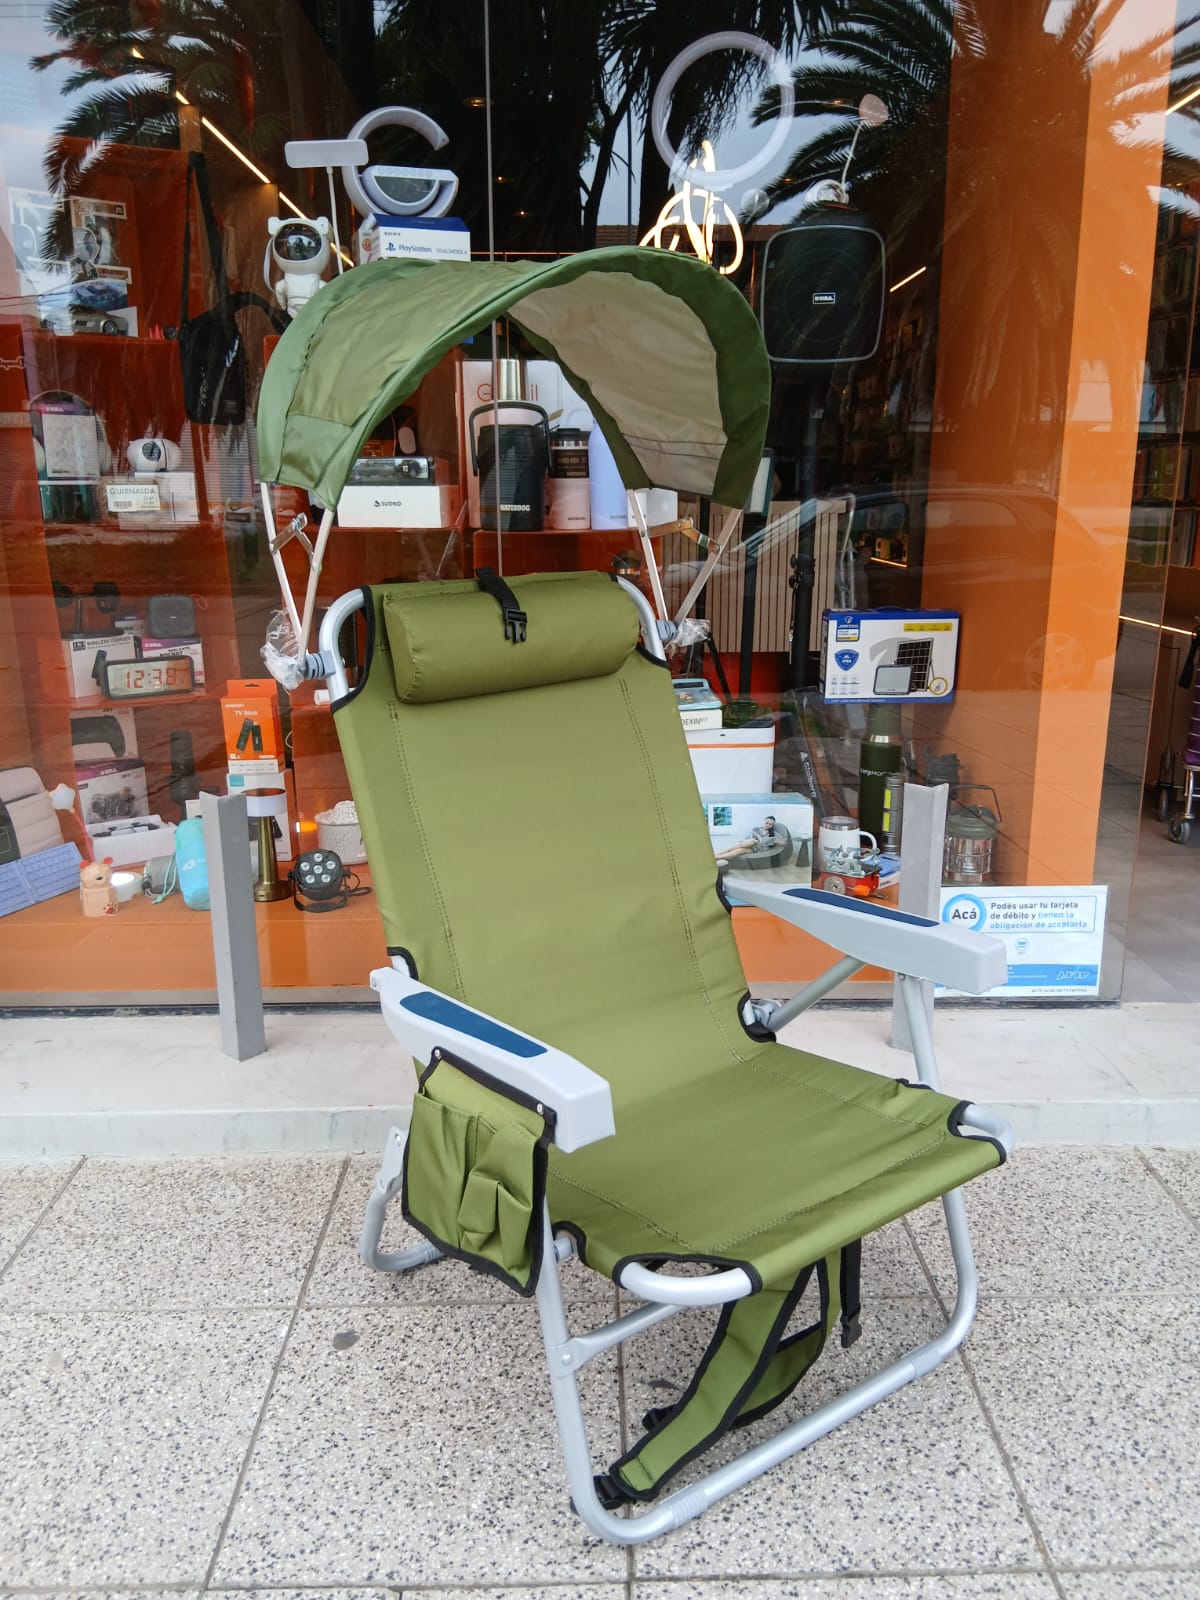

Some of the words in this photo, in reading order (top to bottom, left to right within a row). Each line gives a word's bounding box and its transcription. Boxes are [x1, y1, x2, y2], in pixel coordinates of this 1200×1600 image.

[399, 244, 432, 252] PlayStation
[990, 901, 1016, 910] Podés
[1050, 901, 1078, 910] tarjeta
[951, 907, 977, 920] Acá
[990, 911, 1000, 919] de
[1002, 911, 1029, 919] débito
[1066, 911, 1074, 919] la
[990, 920, 1032, 929] obligación
[1035, 920, 1045, 928] de
[1047, 920, 1087, 929] aceptarla
